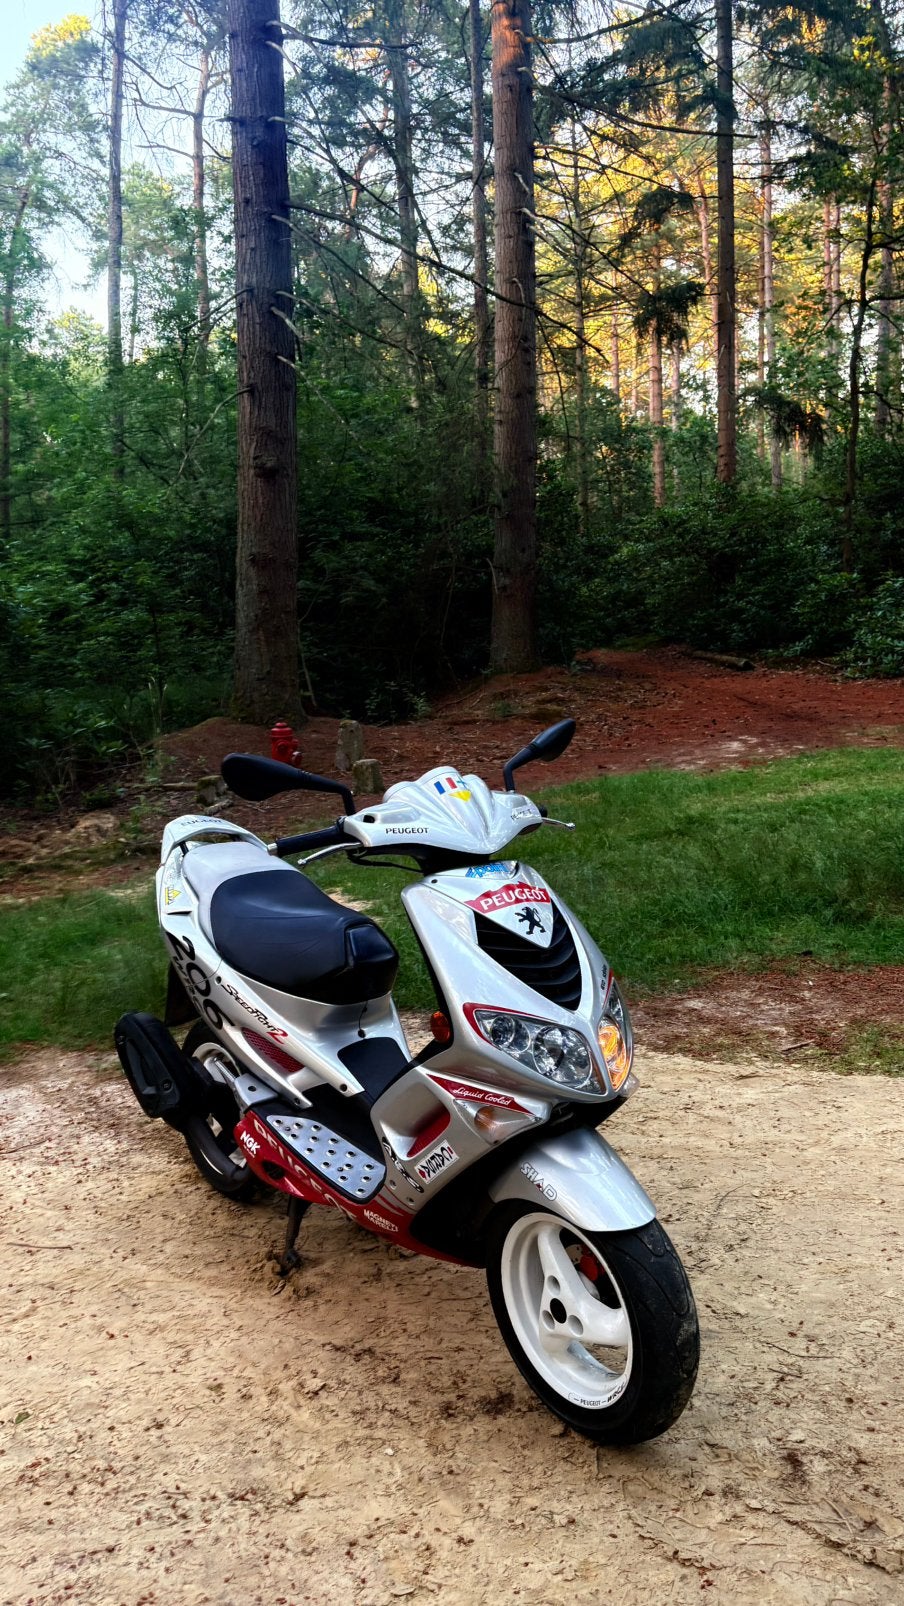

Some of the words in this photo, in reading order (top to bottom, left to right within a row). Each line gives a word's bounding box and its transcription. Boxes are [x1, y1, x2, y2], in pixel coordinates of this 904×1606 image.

[385, 827, 430, 835] PEUGEOT
[480, 887, 547, 911] PEUGEOT
[165, 931, 235, 1030] 206
[267, 1028, 288, 1045] 2
[452, 1087, 483, 1099] Liquid
[484, 1093, 512, 1105] Cooled
[240, 1131, 261, 1155] NGK
[520, 1161, 557, 1201] SHAD
